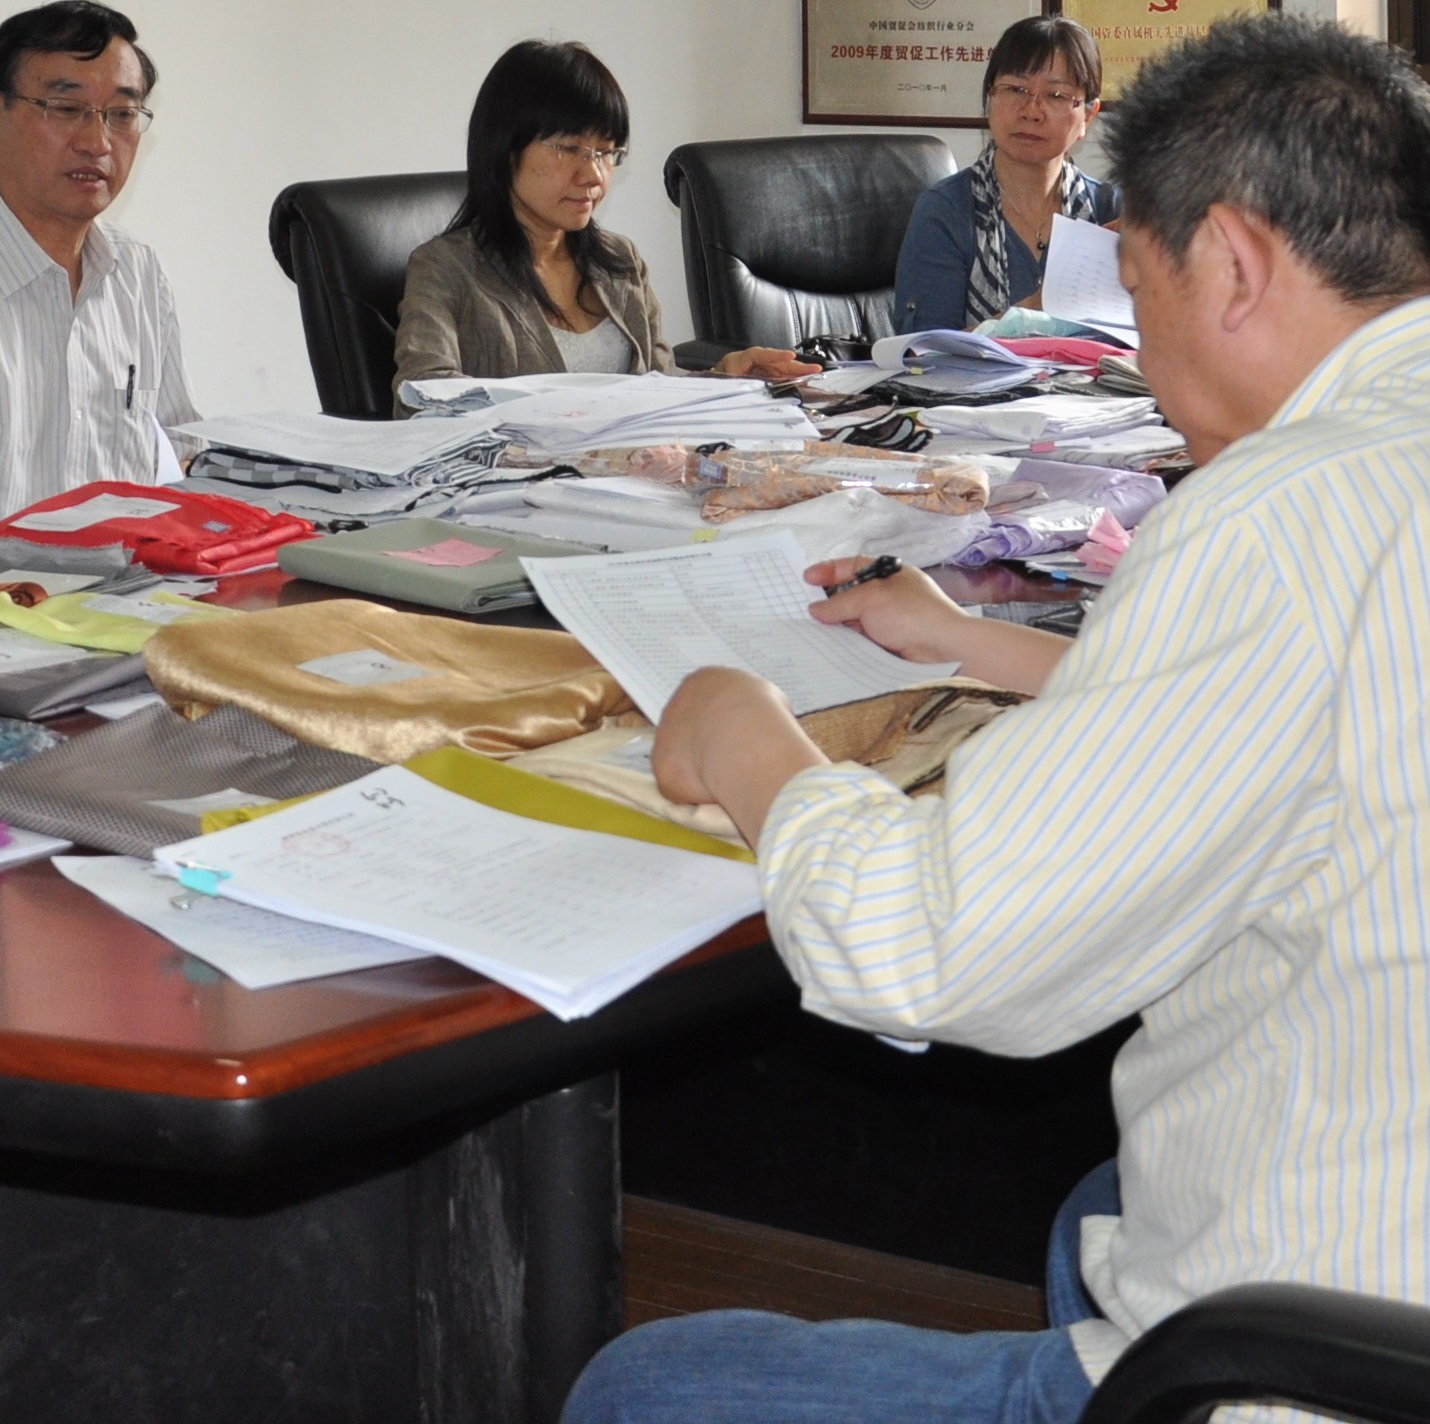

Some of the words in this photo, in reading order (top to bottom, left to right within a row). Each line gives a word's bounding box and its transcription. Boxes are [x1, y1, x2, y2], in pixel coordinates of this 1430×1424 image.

[869, 20, 974, 32] 中国贸促会纺织行业分会
